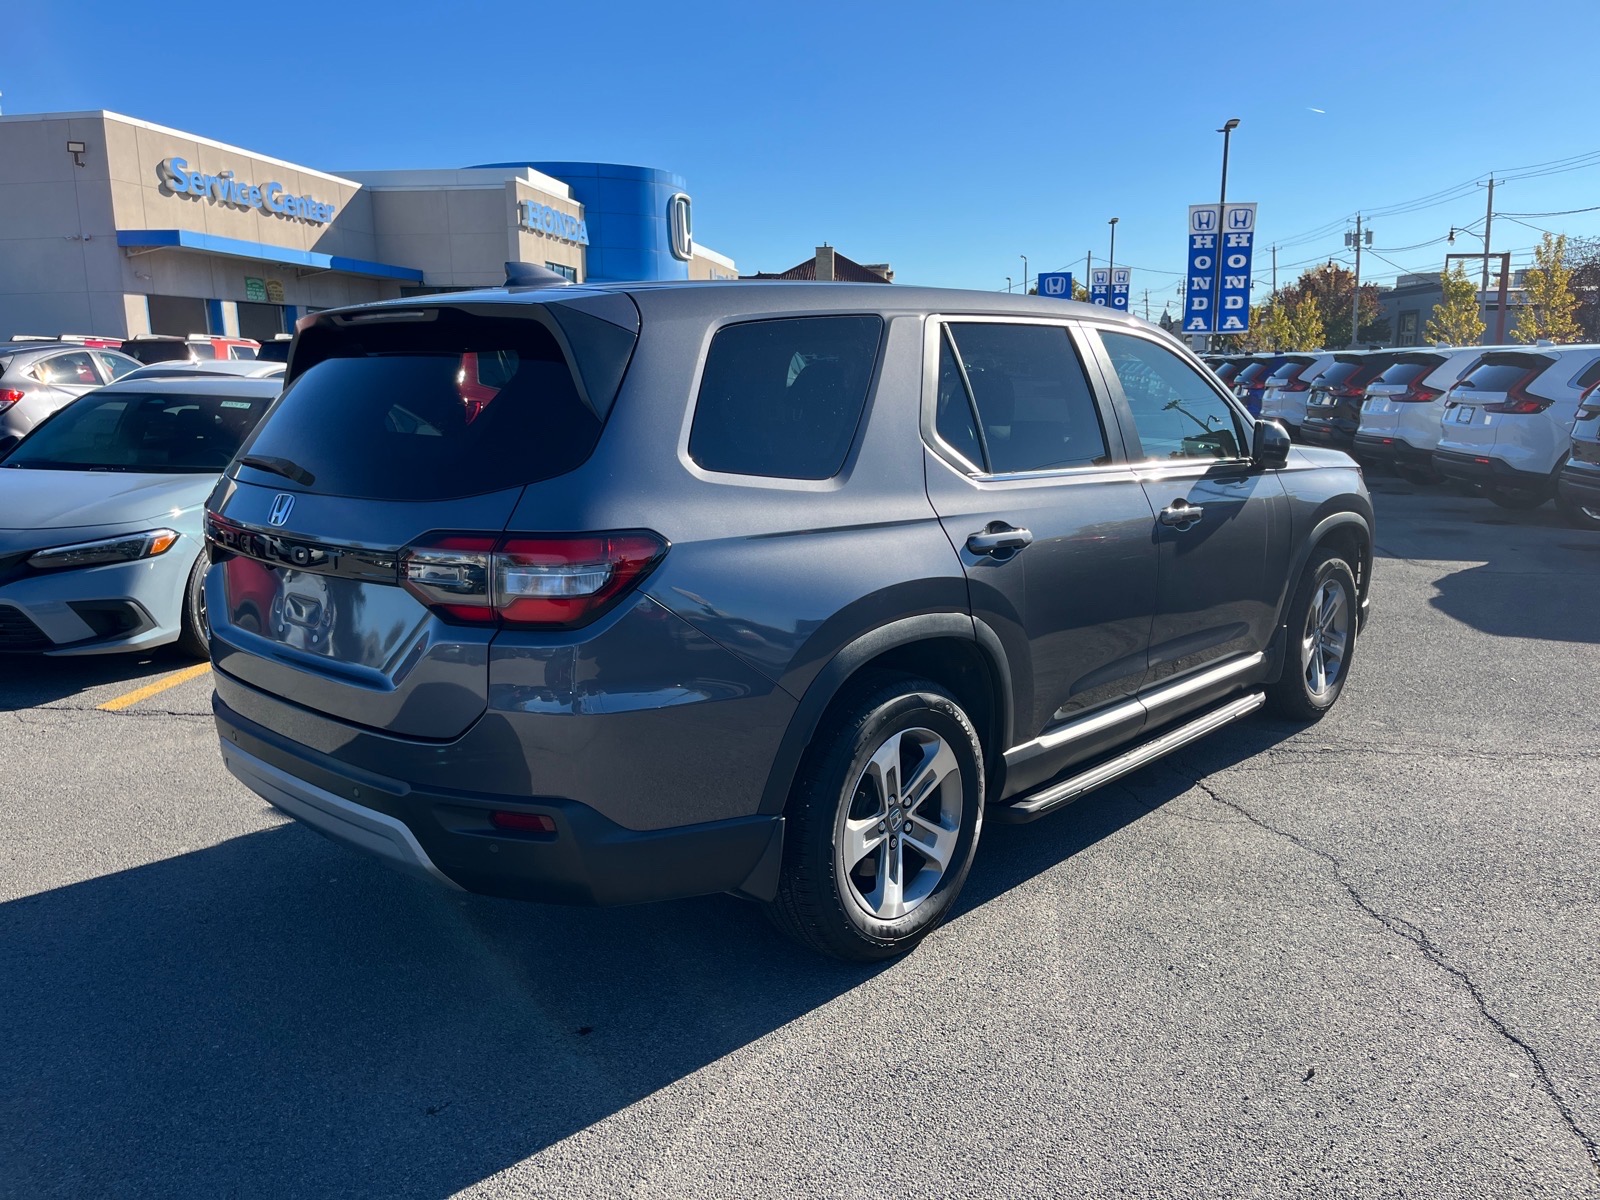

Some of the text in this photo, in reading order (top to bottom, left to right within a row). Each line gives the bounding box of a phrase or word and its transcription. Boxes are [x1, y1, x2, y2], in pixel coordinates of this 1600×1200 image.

[167, 157, 335, 223] Service Center
[526, 200, 590, 245] HONDA
[1187, 235, 1214, 330] HONDA
[1222, 233, 1251, 329] HONDA
[223, 530, 343, 570] PILOT
